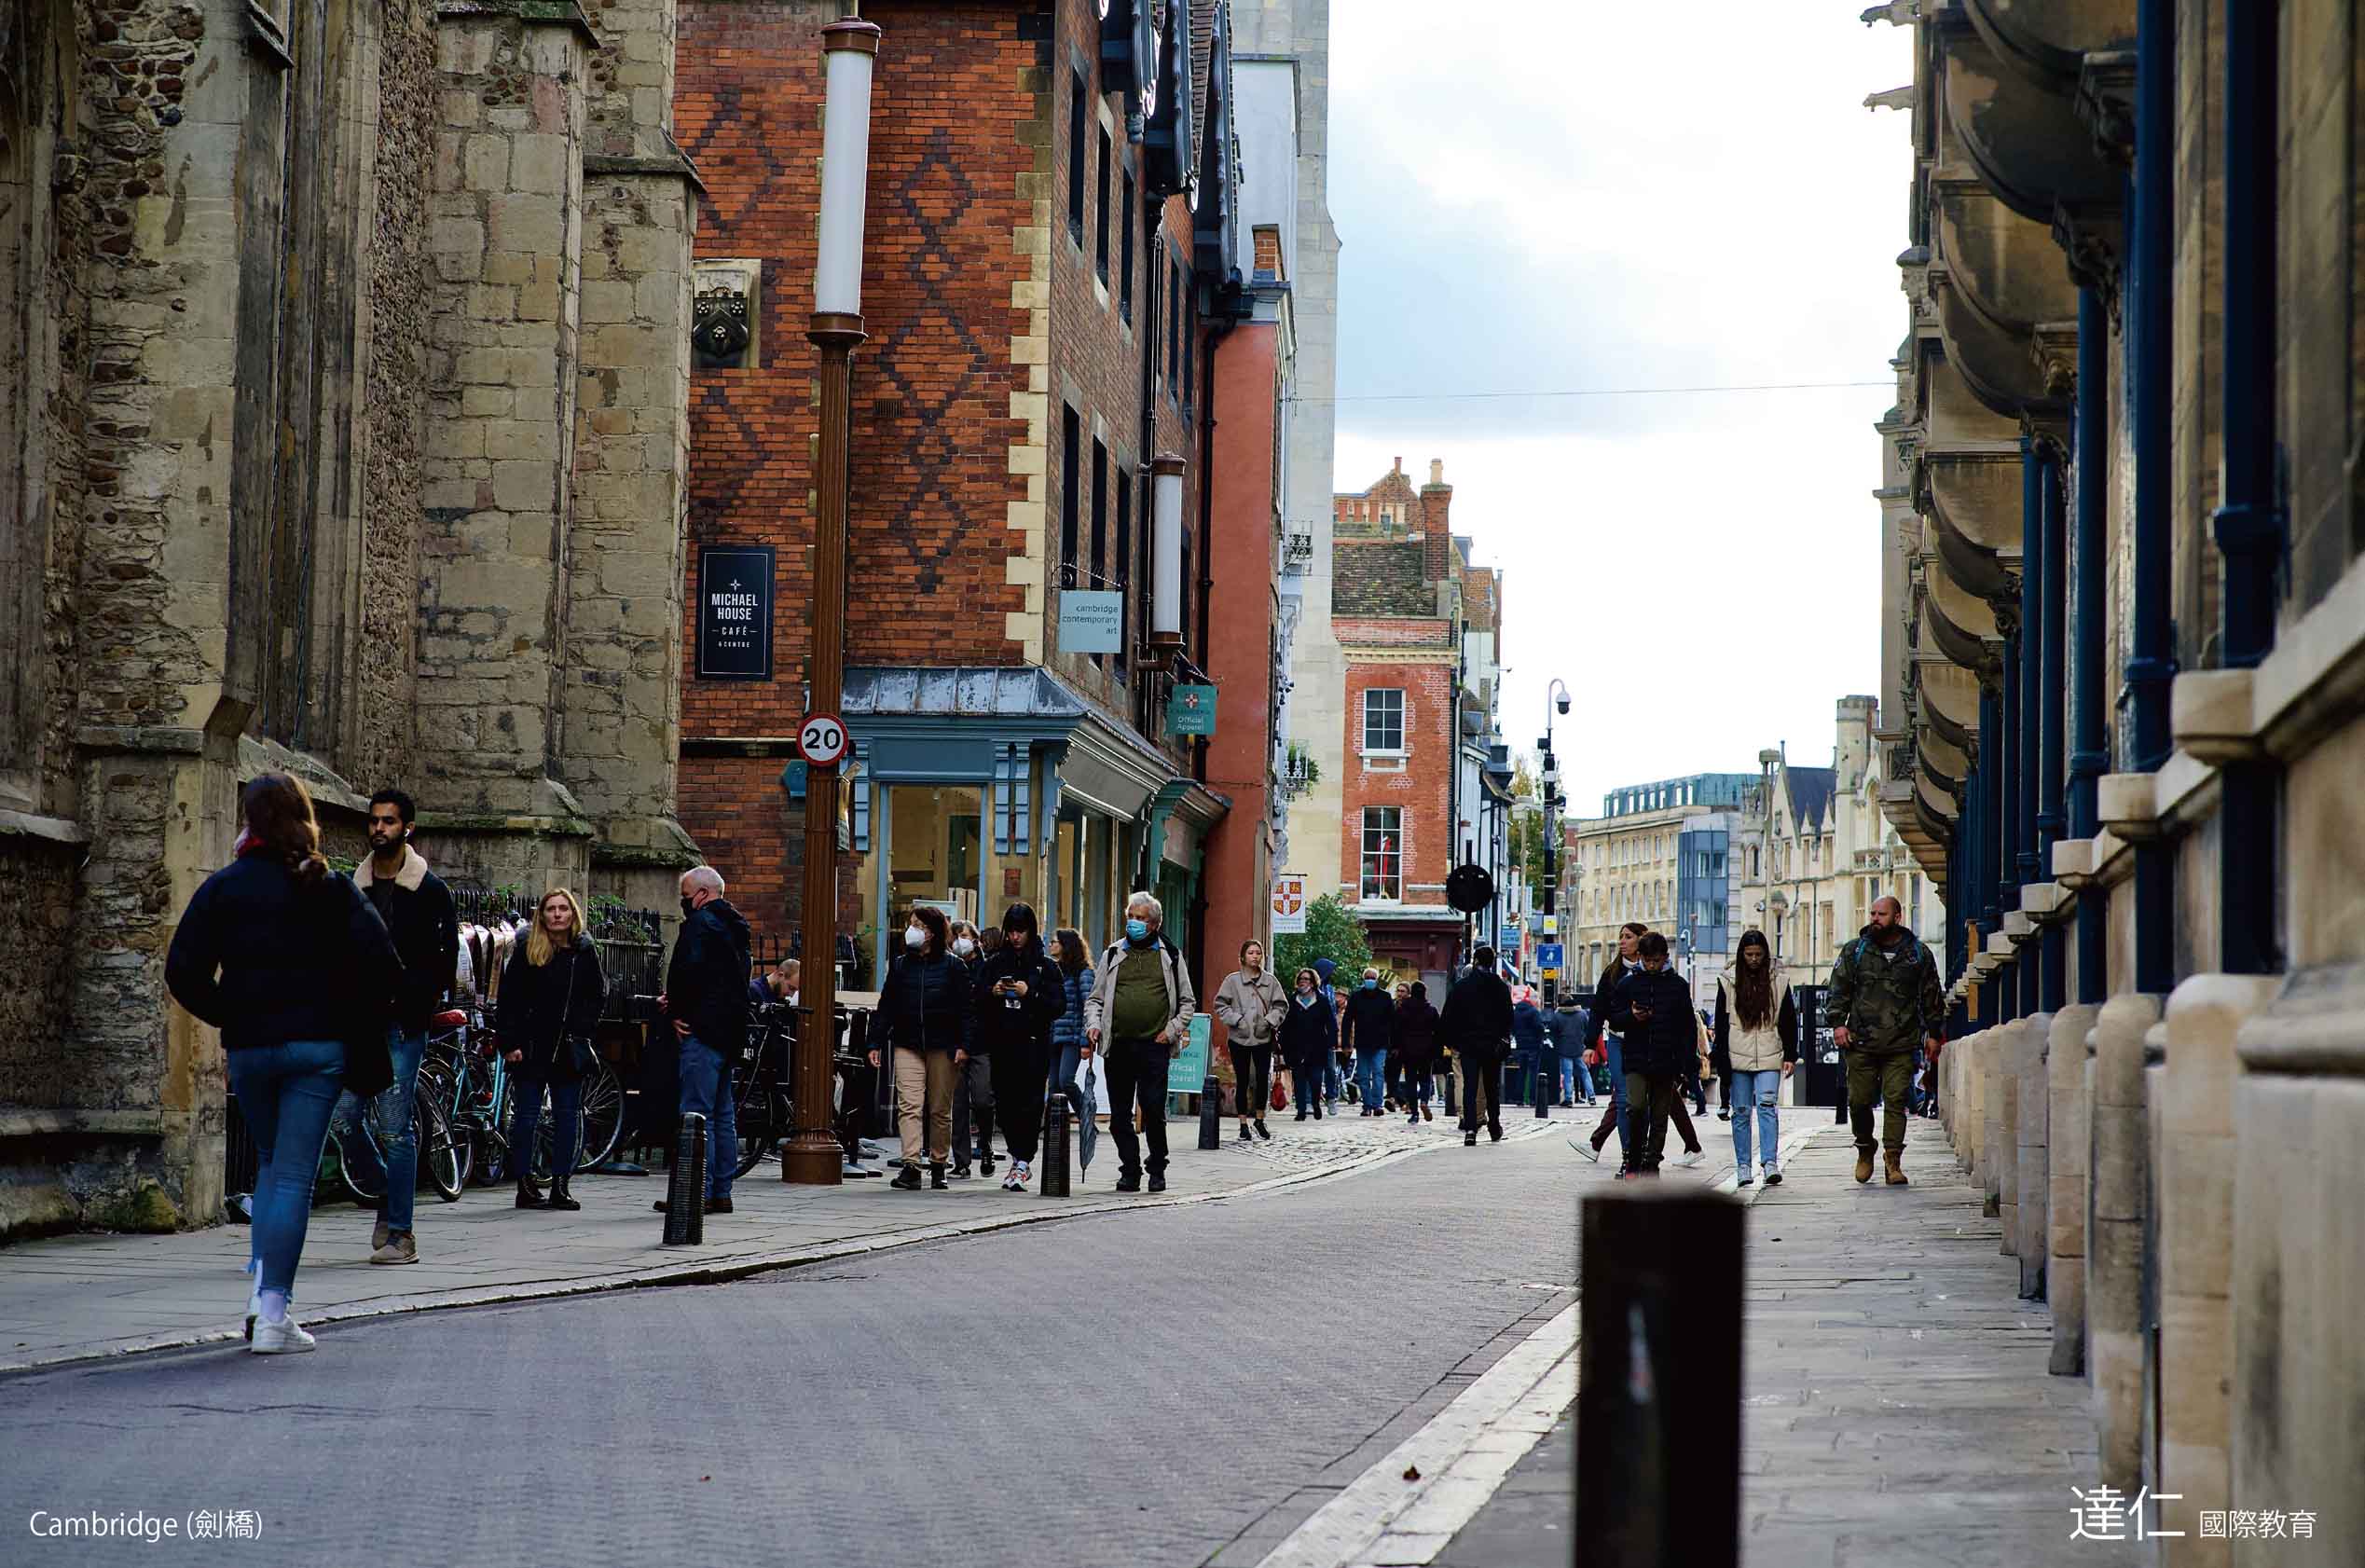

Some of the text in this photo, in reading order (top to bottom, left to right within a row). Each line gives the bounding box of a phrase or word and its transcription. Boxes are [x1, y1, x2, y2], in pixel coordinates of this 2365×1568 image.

[711, 593, 759, 606] MICHAEL
[717, 607, 752, 620] HOUSE
[1076, 604, 1119, 614] cambridge
[1062, 615, 1118, 625] contemporary
[722, 625, 748, 636] CAFÉ
[1105, 626, 1118, 635] art
[1177, 715, 1203, 723] Official
[804, 727, 841, 750] 20
